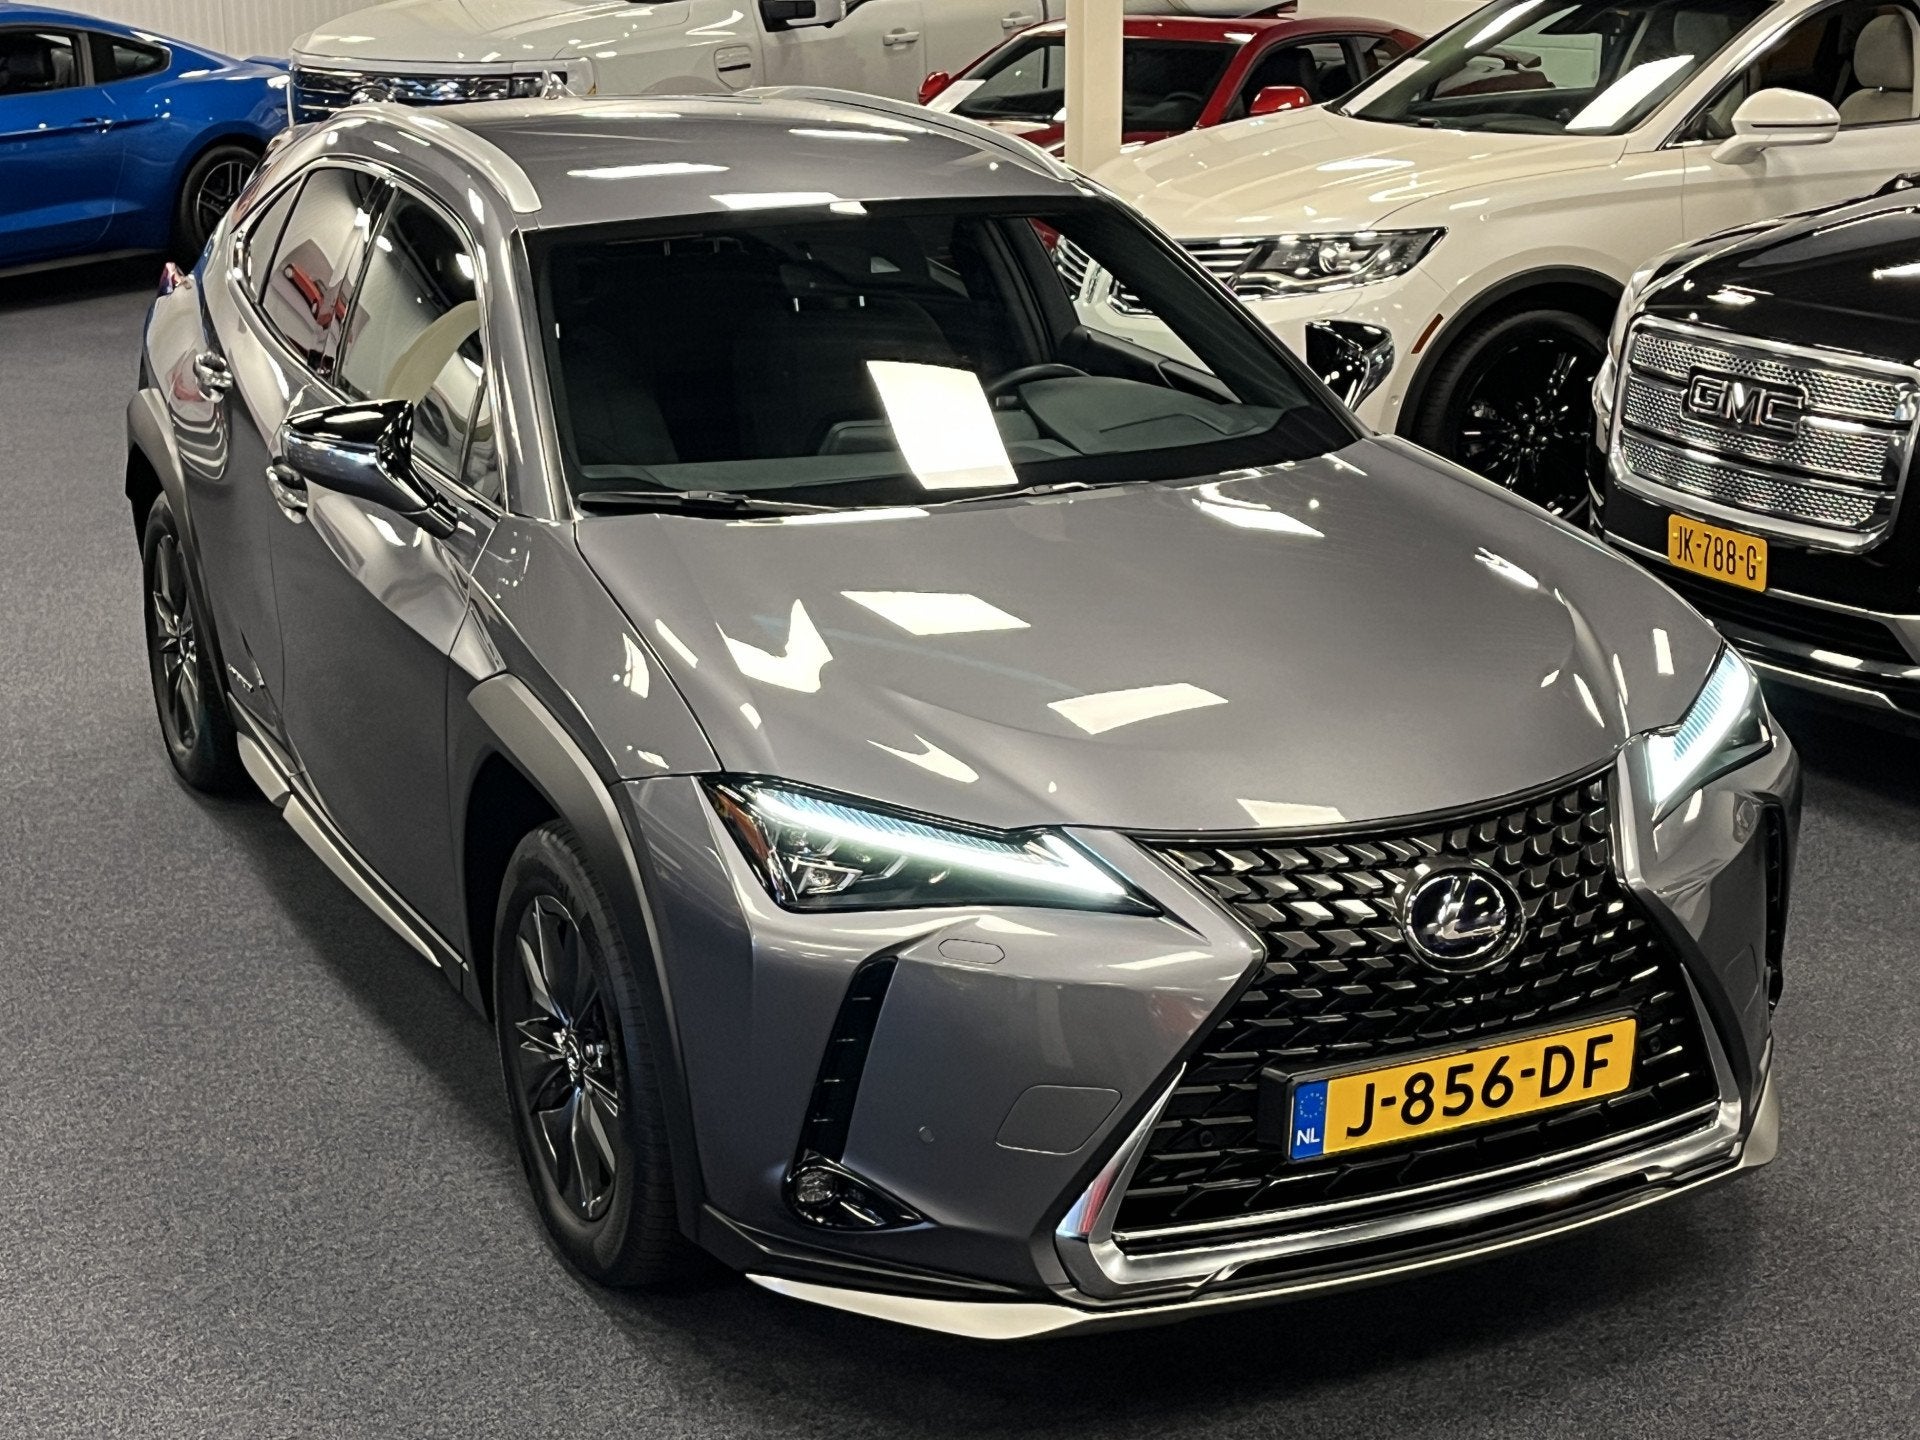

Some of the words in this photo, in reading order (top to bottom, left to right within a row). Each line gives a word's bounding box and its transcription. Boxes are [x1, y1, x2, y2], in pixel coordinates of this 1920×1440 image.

[1688, 374, 1806, 433] GMC
[1676, 525, 1757, 581] JK-788-G
[1346, 1034, 1614, 1139] J-856-DF
[1296, 1129, 1320, 1146] NL
